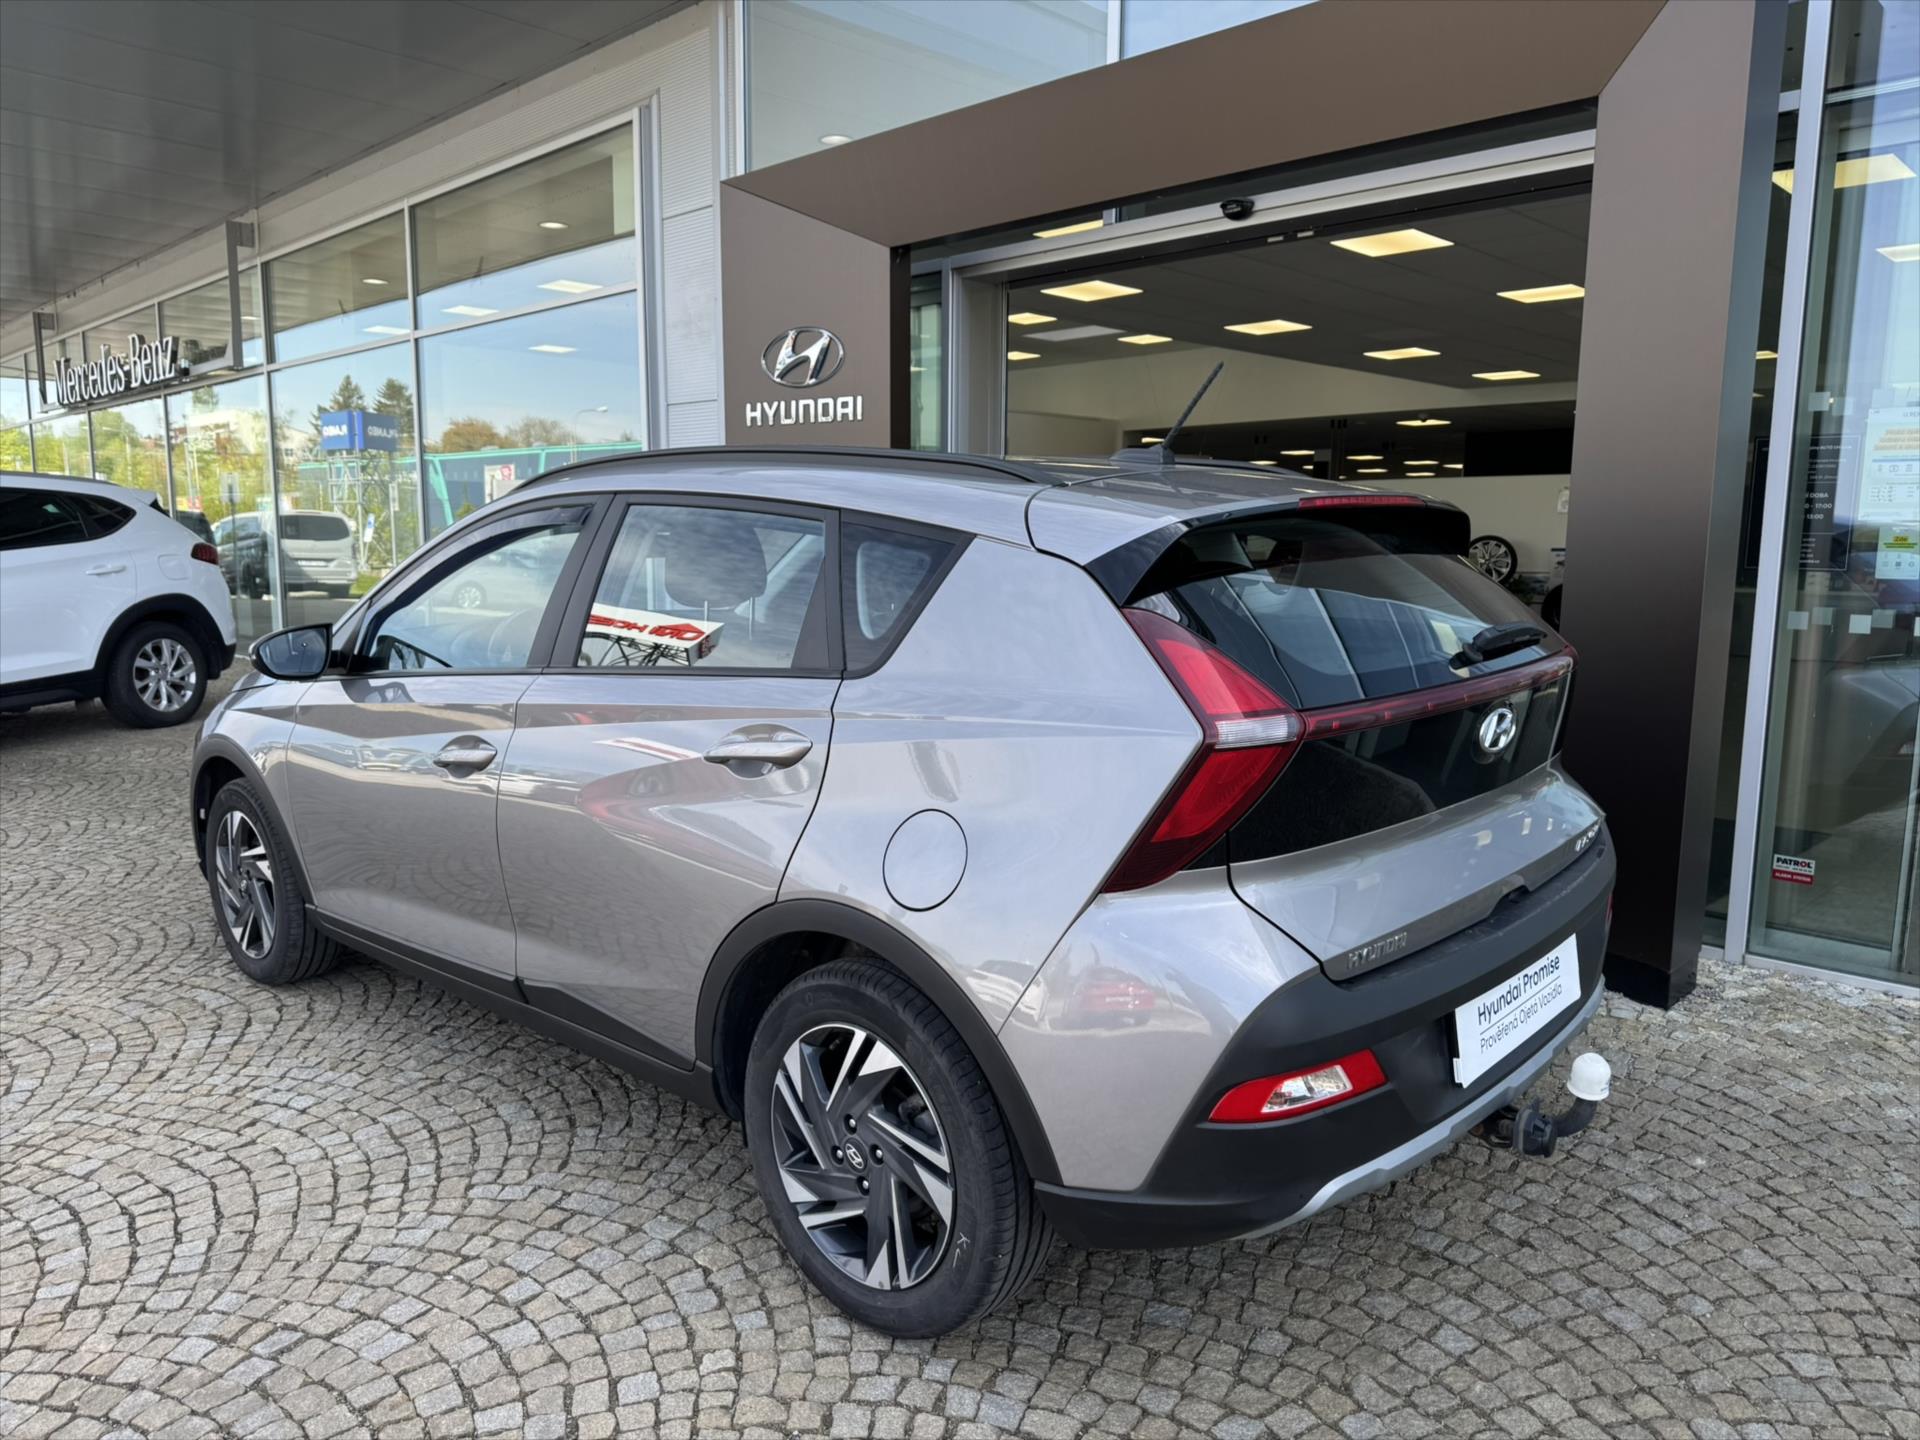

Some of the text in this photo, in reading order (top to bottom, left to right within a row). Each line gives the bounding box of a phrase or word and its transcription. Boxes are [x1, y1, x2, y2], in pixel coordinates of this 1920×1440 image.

[53, 333, 176, 404] Mercedes-Benz
[745, 395, 863, 427] HYUNDAI
[1776, 856, 1813, 869] PATROL
[1347, 932, 1407, 969] HYUNDAI
[1477, 955, 1560, 1026] Hyundai Promise
[1480, 983, 1563, 1054] Prověřená Ojetá Vozidla
